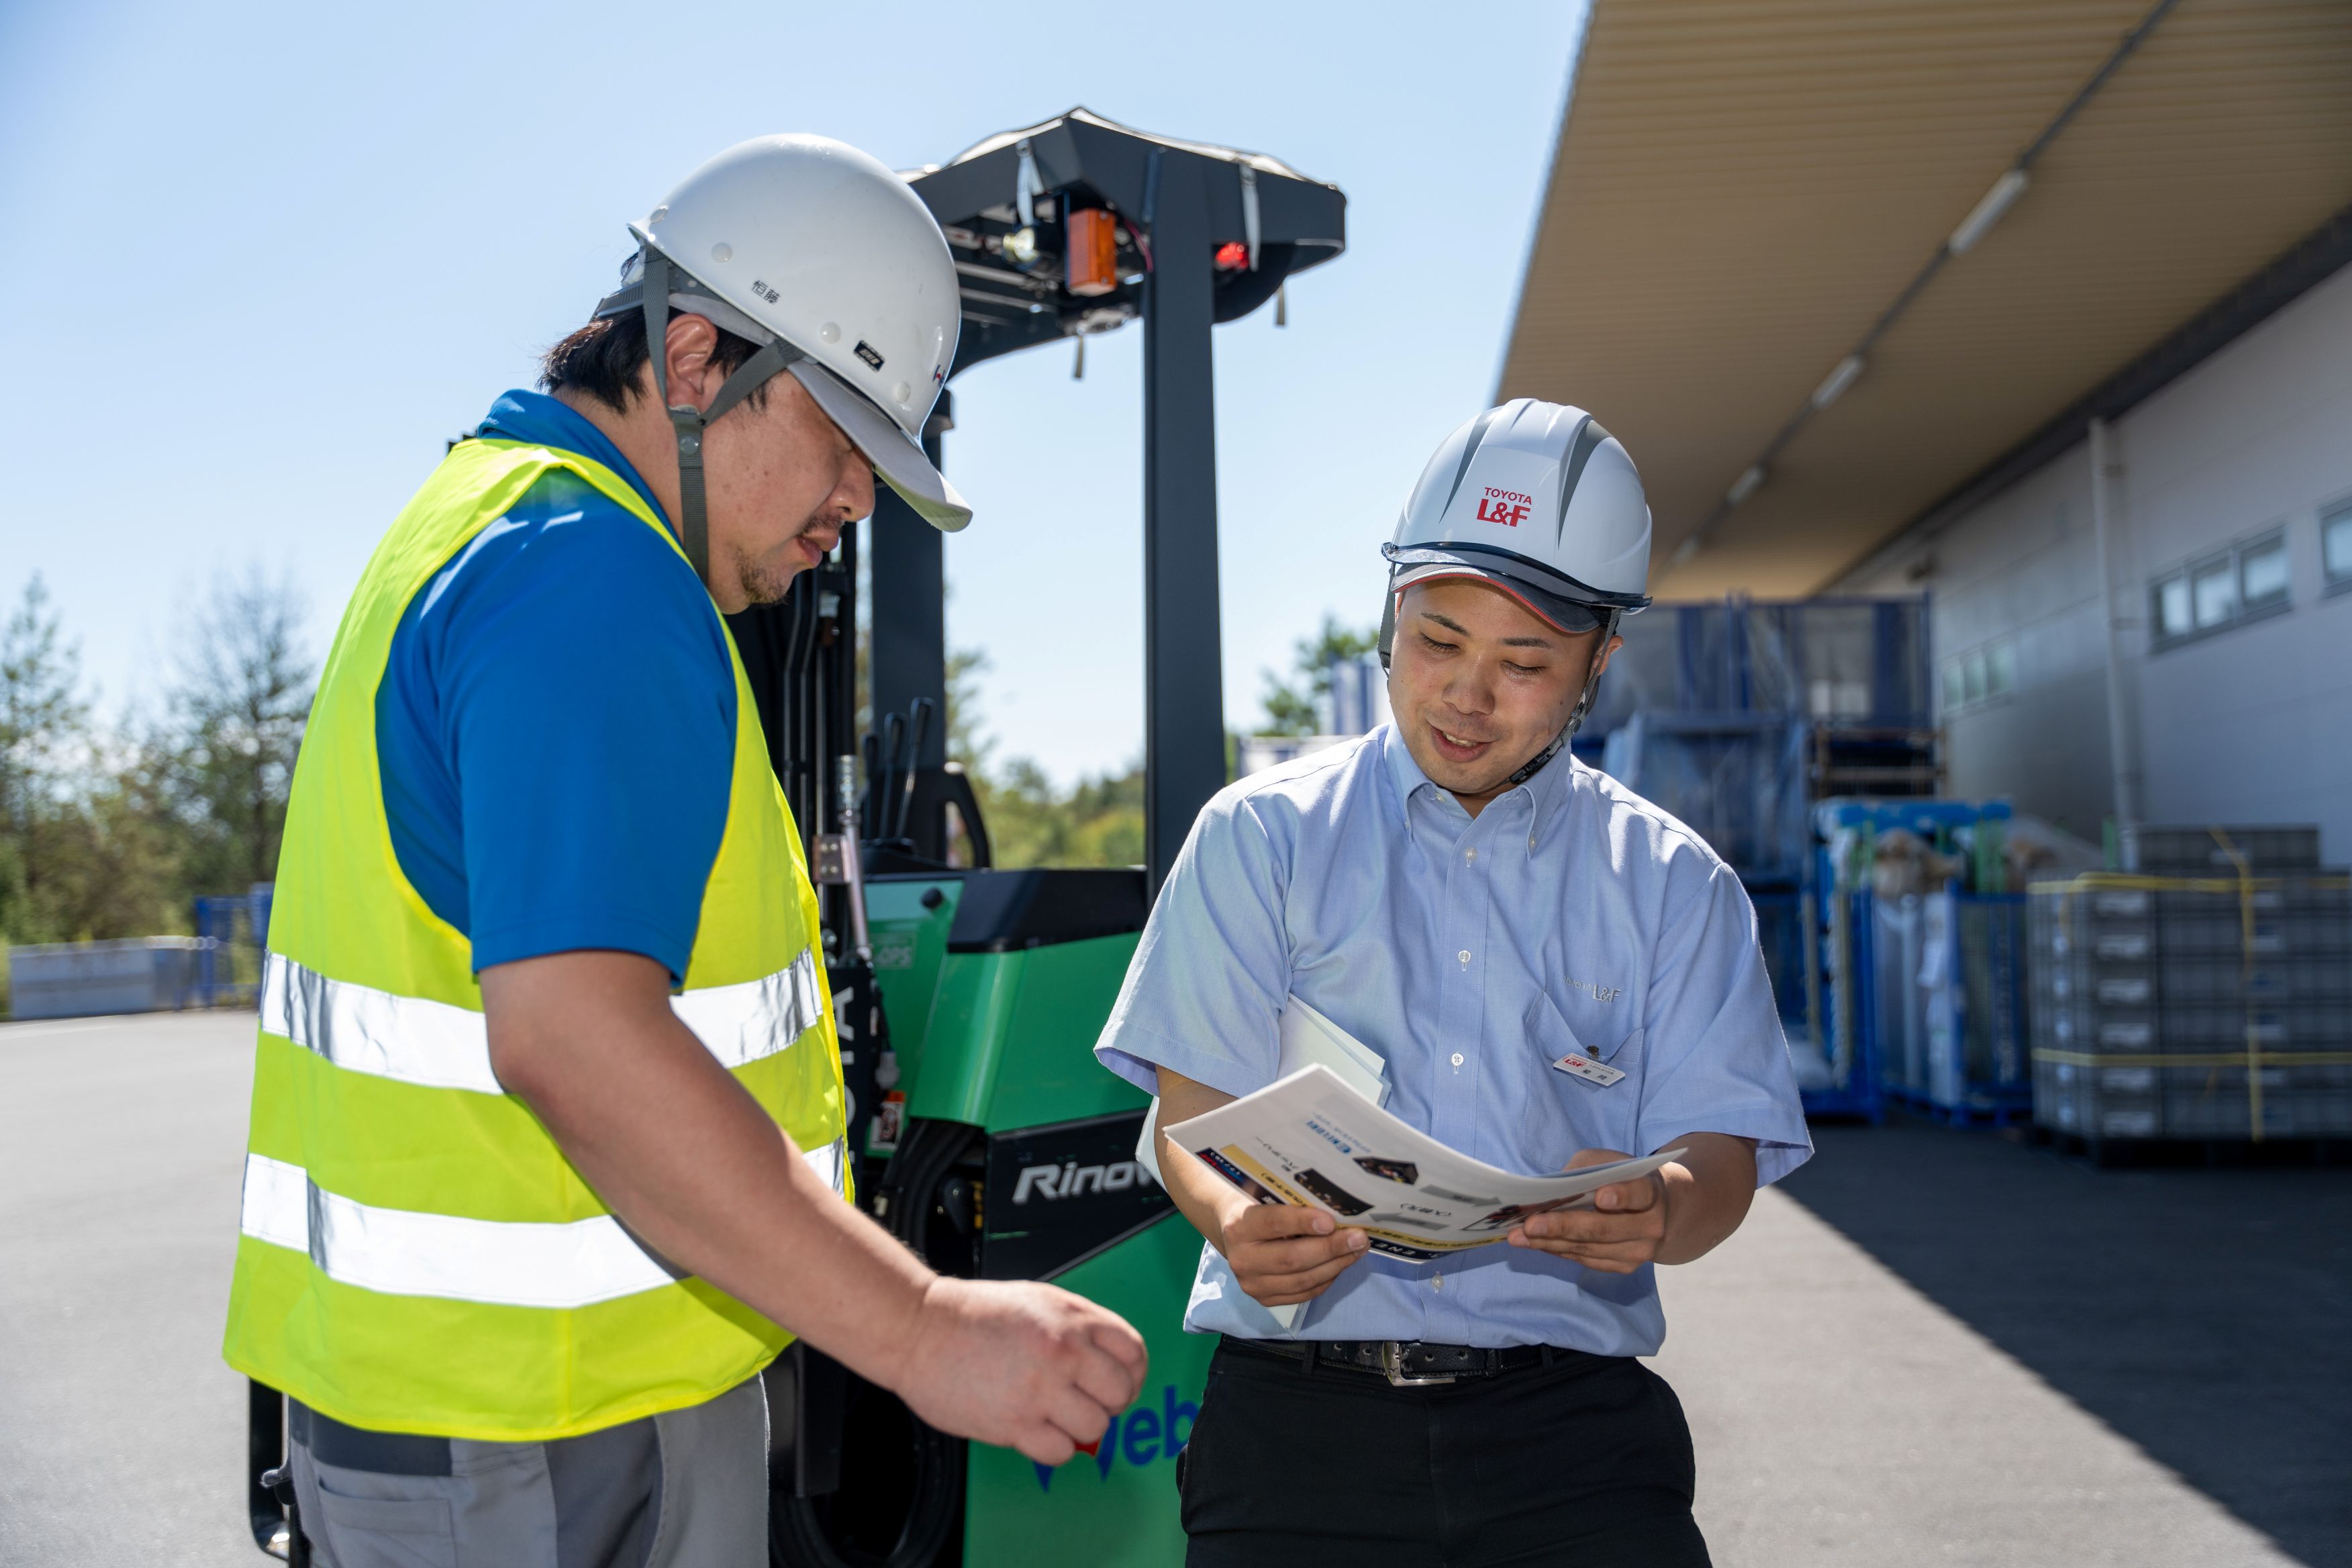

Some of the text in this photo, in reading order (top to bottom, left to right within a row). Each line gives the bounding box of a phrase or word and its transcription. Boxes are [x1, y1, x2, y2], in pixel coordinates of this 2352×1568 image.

[752, 280, 781, 305] 恒藤
[1484, 487, 1532, 505] TOYOTA
[1477, 498, 1531, 527] L&F
[1563, 977, 1622, 1003] TOYOTA L&F
[1563, 1059, 1585, 1067] L&F
[1369, 1240, 1416, 1256] ENE
